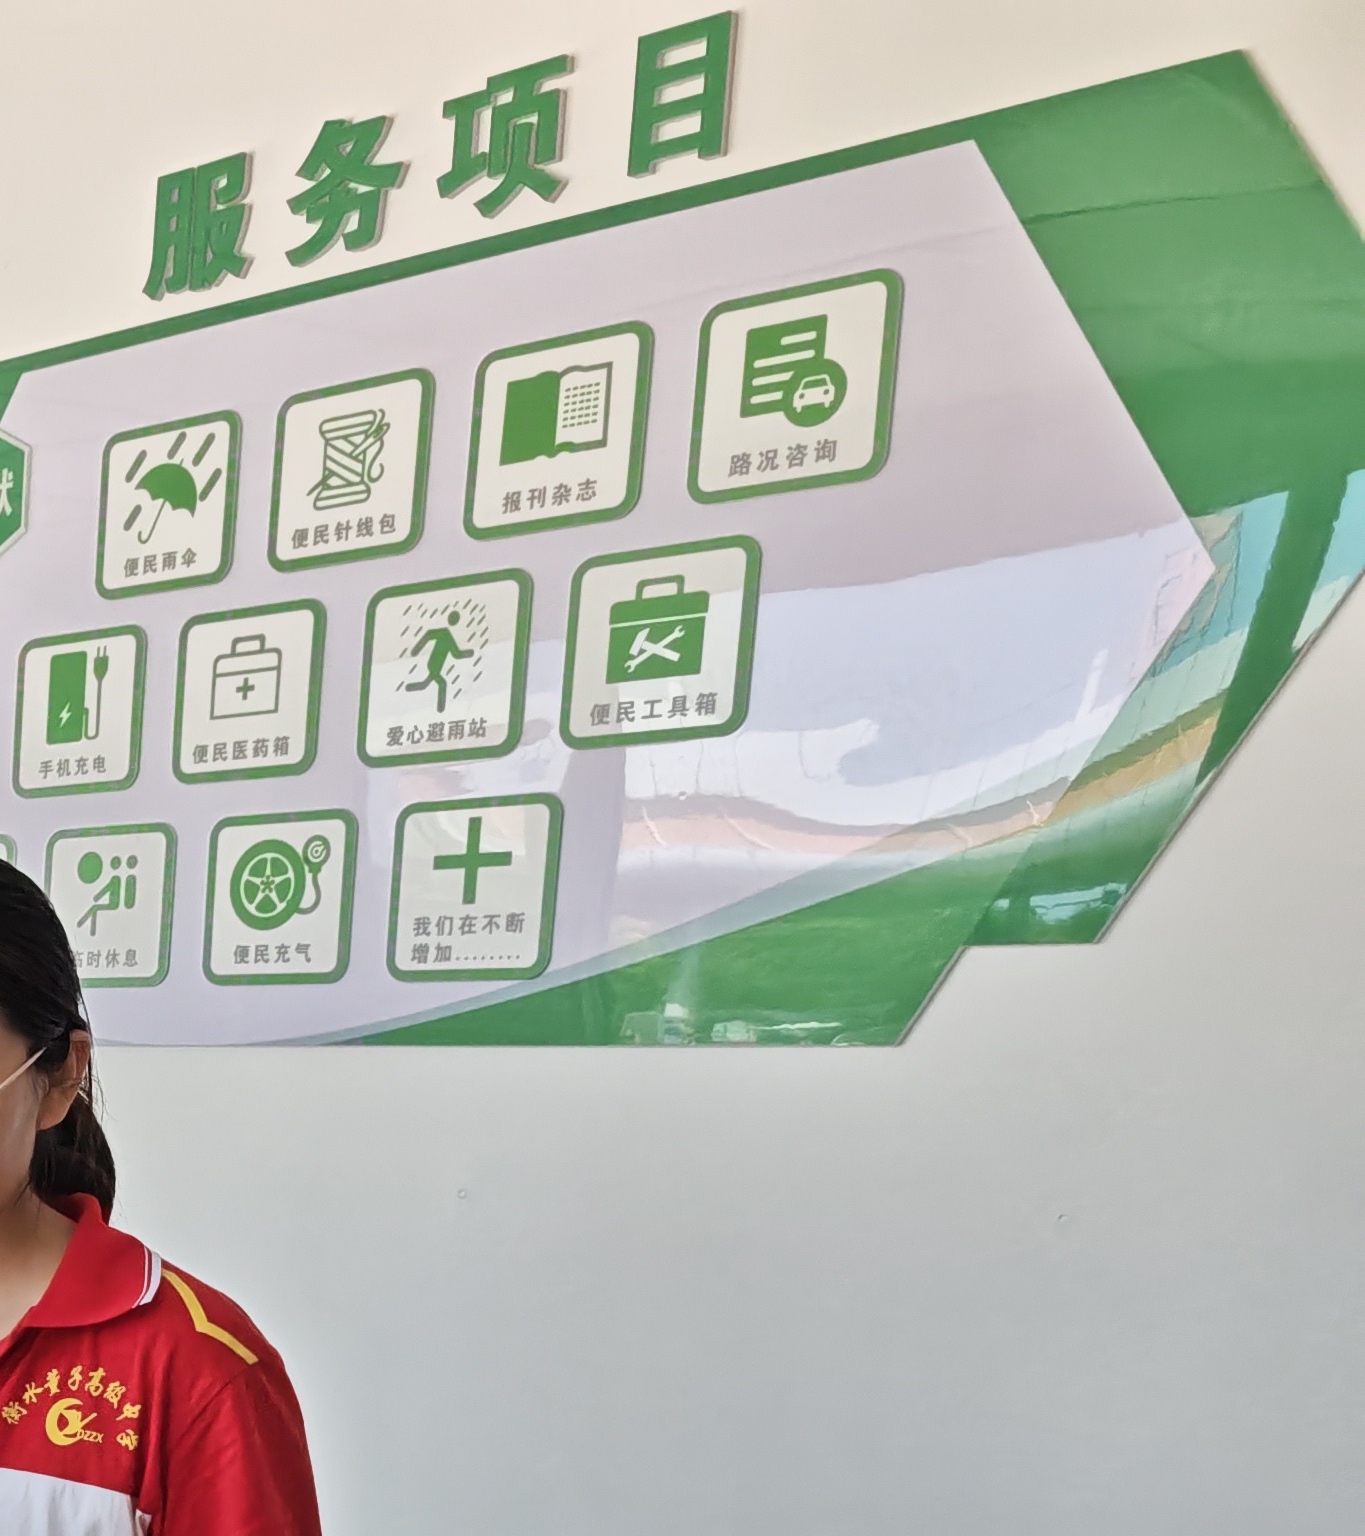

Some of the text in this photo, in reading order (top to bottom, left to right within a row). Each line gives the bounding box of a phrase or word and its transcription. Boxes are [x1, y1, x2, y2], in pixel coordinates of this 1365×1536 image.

[142, 9, 739, 300] 服务项目
[728, 438, 839, 479] 路况咨询
[501, 477, 599, 515] 报刊杂志
[291, 511, 399, 551] 便民针线包
[123, 549, 198, 579] 便民雨伞
[588, 691, 720, 729] 便民工具箱
[385, 717, 488, 748] 爱心避雨站
[191, 735, 291, 767] 便民医药箱
[38, 755, 108, 780] 手机充电
[412, 911, 526, 938] 我们在不断
[232, 940, 314, 966] 便民充气
